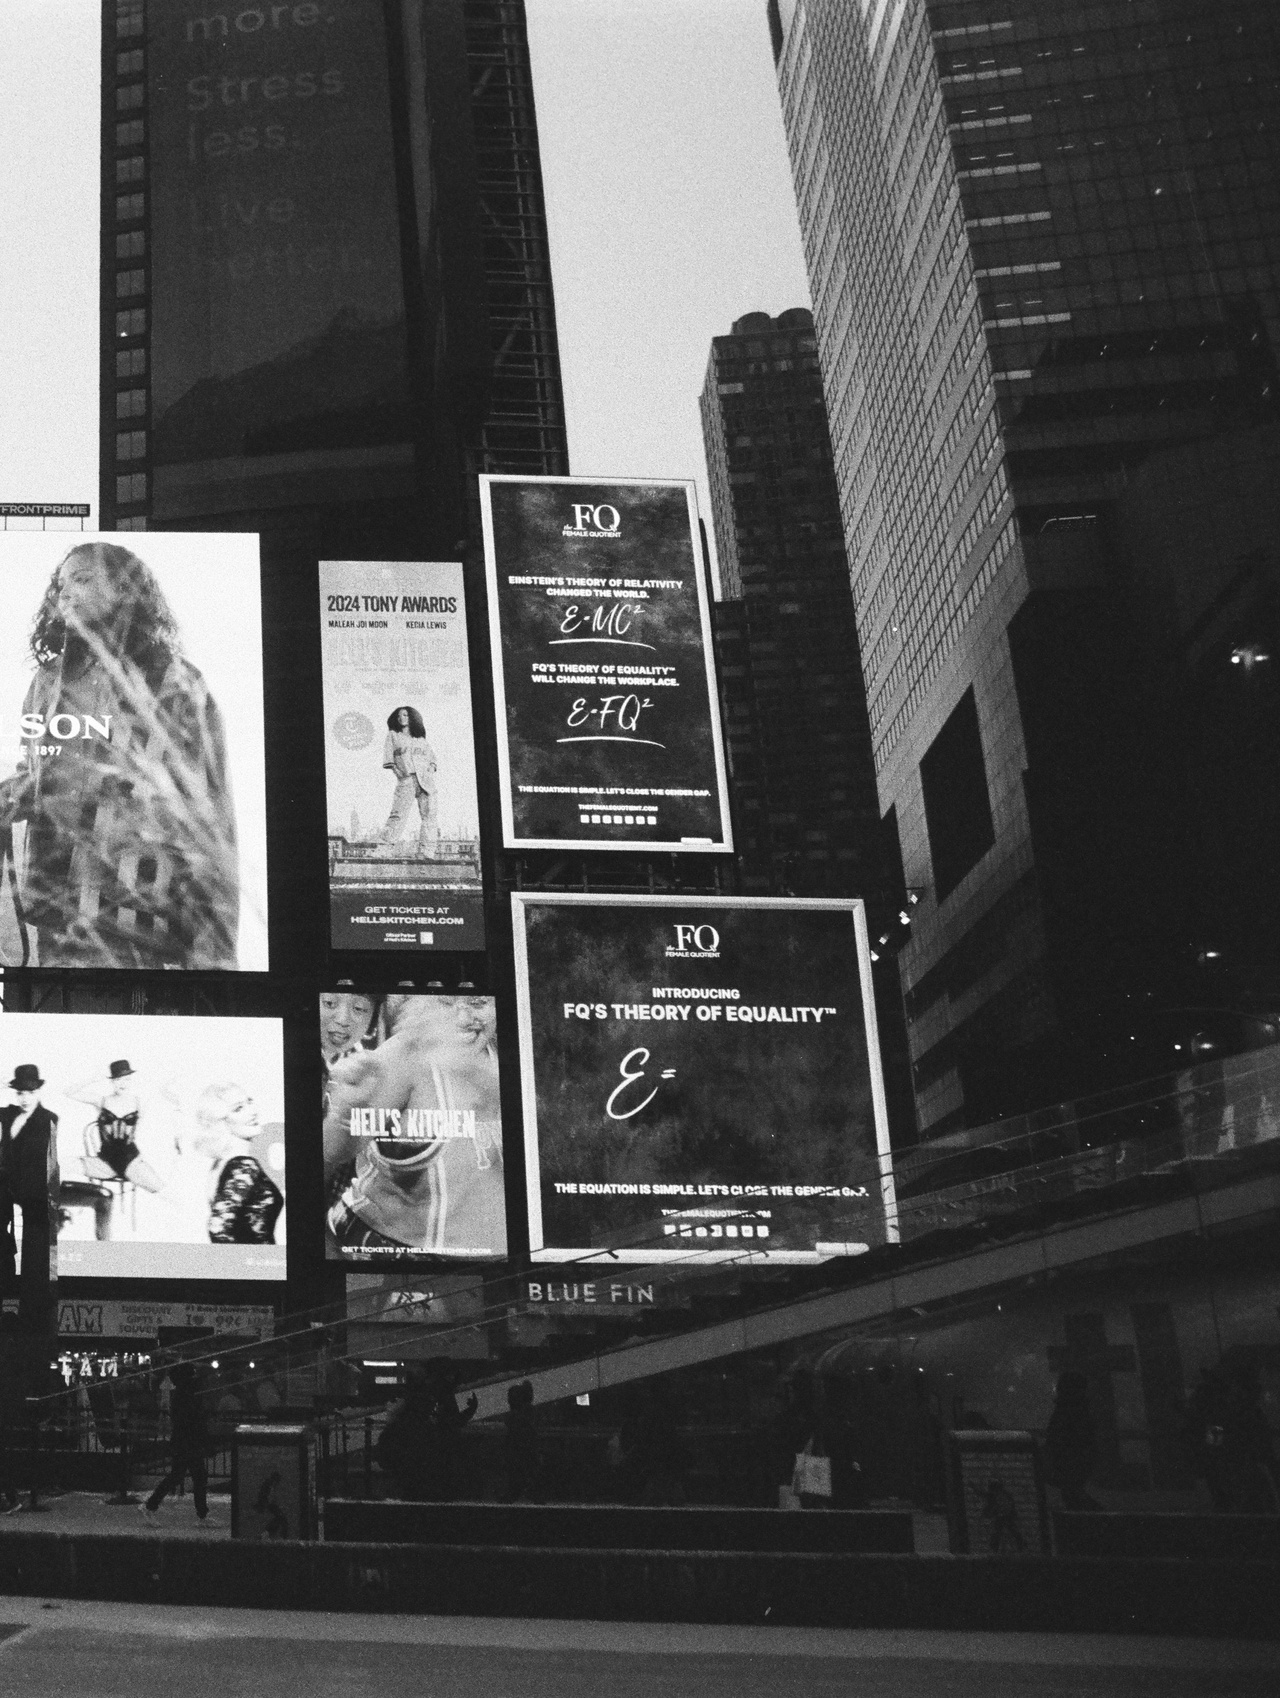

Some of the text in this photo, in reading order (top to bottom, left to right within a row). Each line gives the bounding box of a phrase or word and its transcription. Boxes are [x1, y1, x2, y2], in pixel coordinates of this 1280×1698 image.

[183, 1, 336, 42] more.
[186, 67, 345, 113] Stress
[190, 194, 297, 233] Live
[571, 503, 621, 532] FQ
[508, 575, 683, 589] EINSTEIN'S THEORY OF RELATIVITY
[546, 588, 650, 599] CHANGED THE WORLD.
[327, 595, 458, 614] 2024 TONY AWARDS
[328, 620, 355, 628] MALEAH
[426, 622, 448, 630] LEWIS
[532, 663, 556, 673] FQ'S
[558, 664, 599, 674] THEORY
[601, 665, 615, 674] OF
[532, 675, 680, 687] WILL CHANGE THE WORKPLACE.
[33, 745, 63, 756] 1897
[518, 785, 534, 793] THE
[534, 786, 571, 794] EQUATION
[571, 786, 578, 794] IS
[626, 788, 650, 796] CLOSE
[650, 788, 665, 796] THE
[665, 789, 693, 797] GENDER
[364, 906, 450, 915] GET TICKETS AT
[350, 916, 464, 925] HELLSKITCHEN.COM
[673, 924, 720, 952] FQ
[652, 987, 740, 1000] INTRODUCING
[564, 1002, 608, 1020] FQ'S
[611, 1003, 692, 1021] THEORY
[695, 1004, 723, 1021] OF
[350, 1107, 476, 1138] HELL'S KITCHEN
[554, 1183, 578, 1194] THE
[579, 1183, 638, 1195] EQUATION
[639, 1184, 651, 1195] IS
[652, 1184, 697, 1195] SIMPLE.
[698, 1184, 729, 1196] LET'S
[770, 1186, 793, 1196] THE
[360, 1246, 394, 1254] TICKETS
[528, 1282, 654, 1303] BLUE FIN
